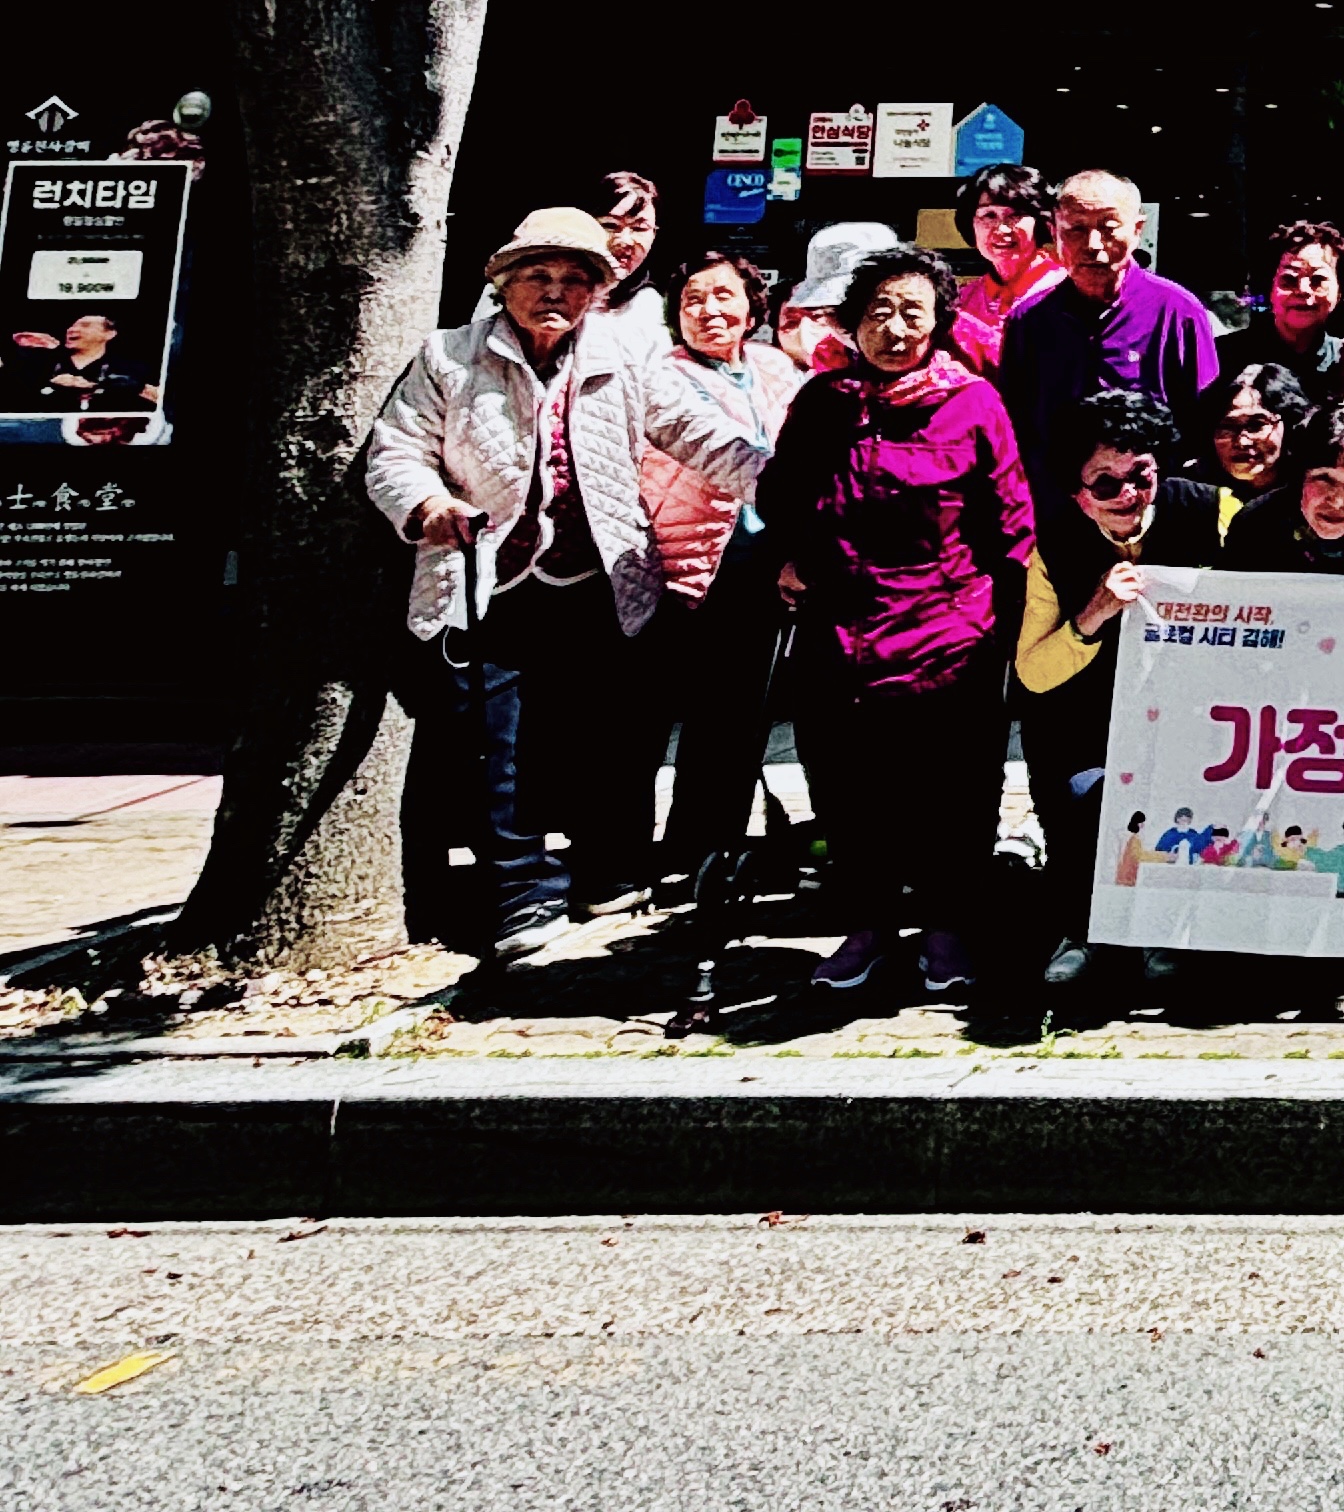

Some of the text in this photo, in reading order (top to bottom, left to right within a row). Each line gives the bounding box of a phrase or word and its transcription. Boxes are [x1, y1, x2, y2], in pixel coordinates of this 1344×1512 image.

[33, 180, 157, 209] 런치타임
[1199, 625, 1237, 647] 시티
[1242, 628, 1286, 649] 김해!
